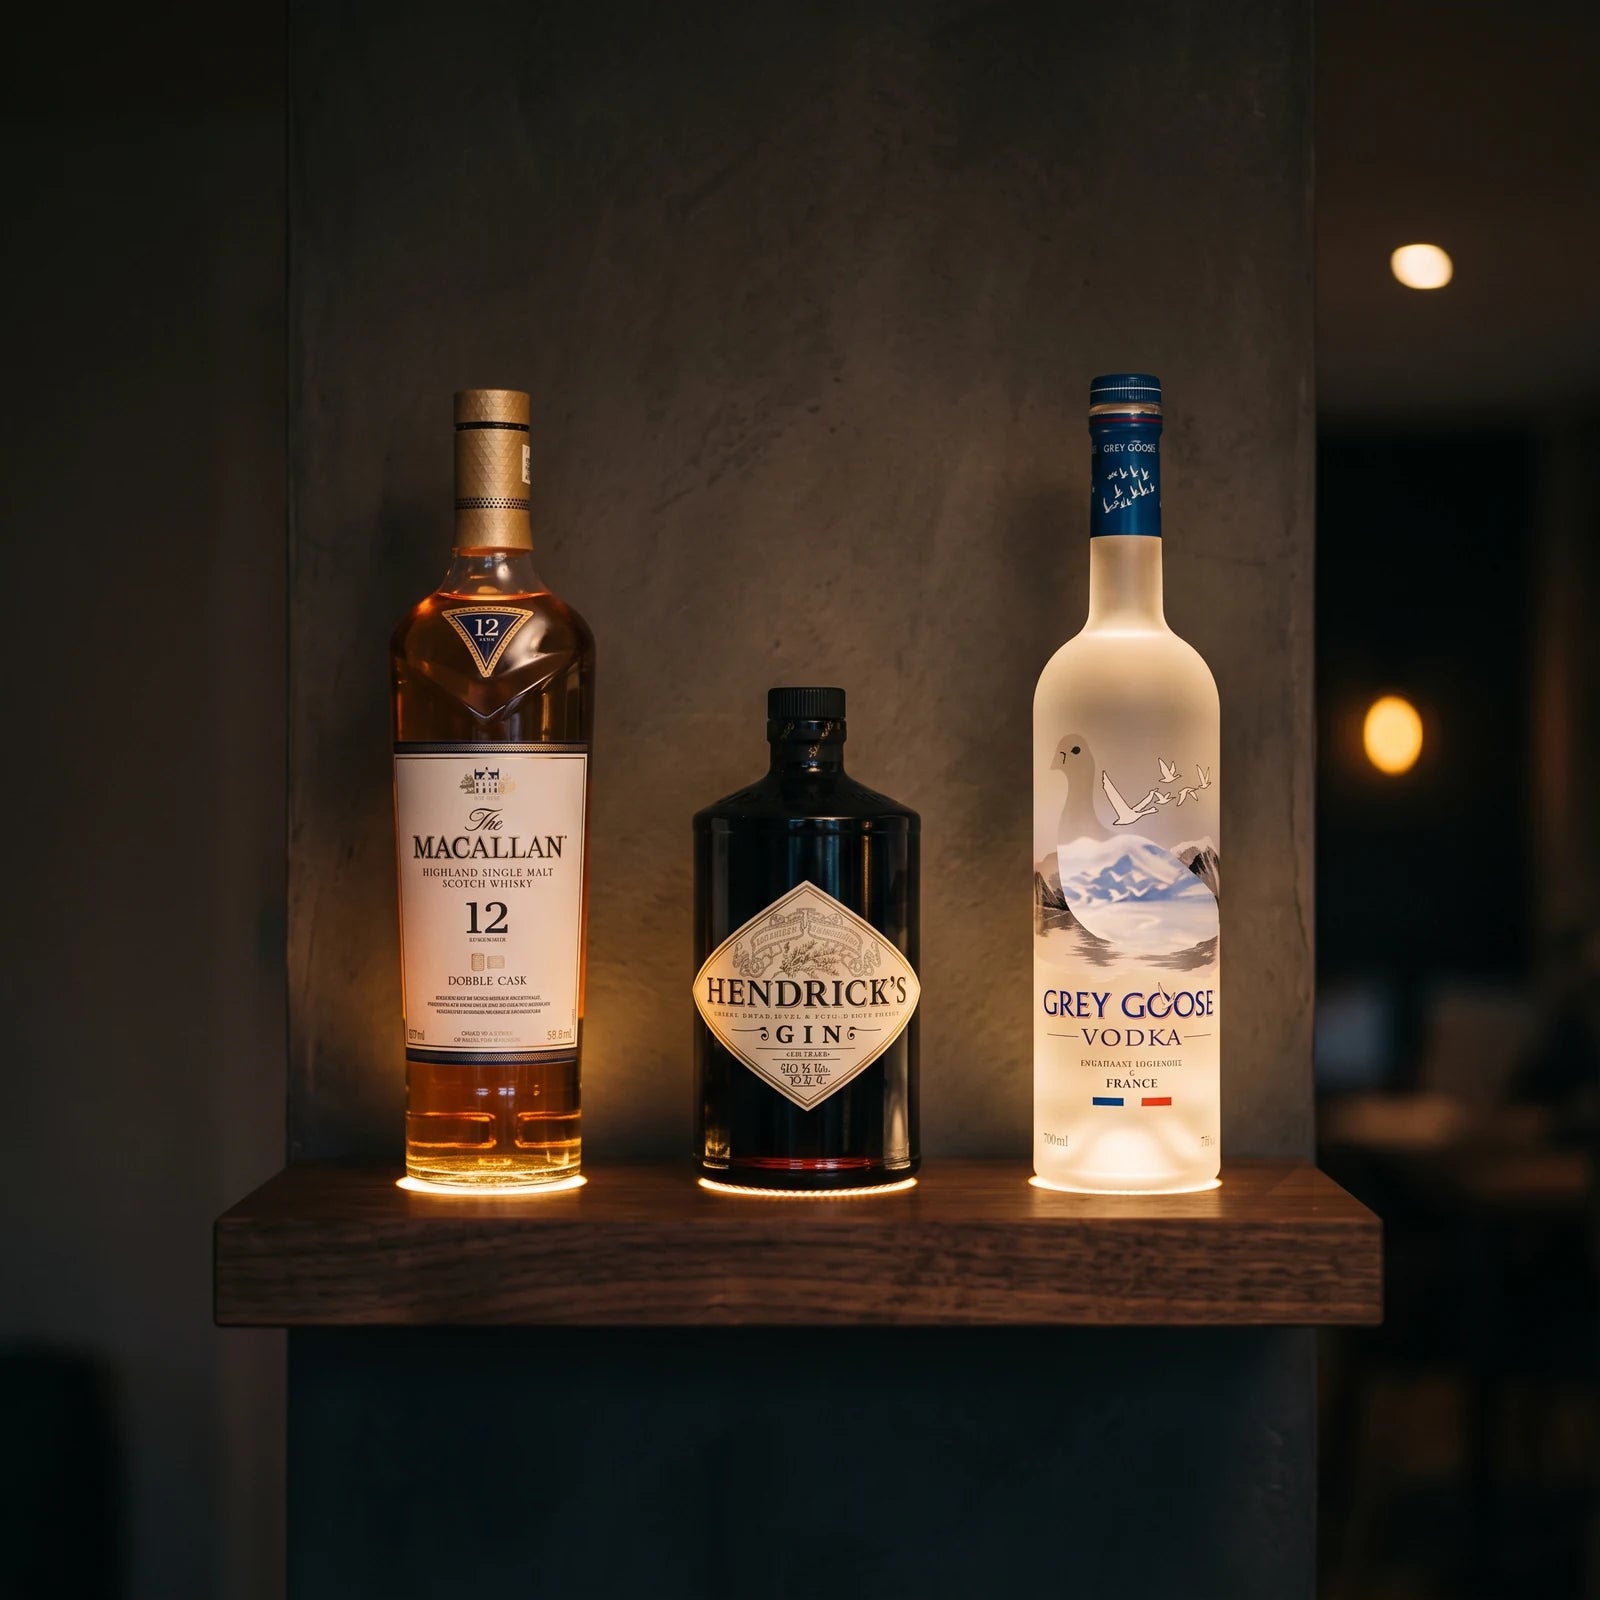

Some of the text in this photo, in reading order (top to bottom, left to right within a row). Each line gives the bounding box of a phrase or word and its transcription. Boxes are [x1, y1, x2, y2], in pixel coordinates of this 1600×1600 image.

[1103, 444, 1125, 453] GREY
[1127, 443, 1156, 453] GOOSE
[475, 618, 499, 636] 12
[464, 807, 504, 832] The
[413, 834, 567, 860] MACALLAN
[422, 867, 554, 878] HIGHLAND SINGLE MALT
[442, 879, 533, 888] SCOTCH WHISKY
[466, 901, 509, 934] 12
[448, 975, 527, 986] DOBBLE CASK
[706, 975, 907, 1009] HENDRICK'S
[1043, 988, 1215, 1019] GREY GOOSE
[775, 1025, 842, 1044] GIN
[1081, 1028, 1183, 1047] VODKA
[1106, 1078, 1158, 1089] FRANCE
